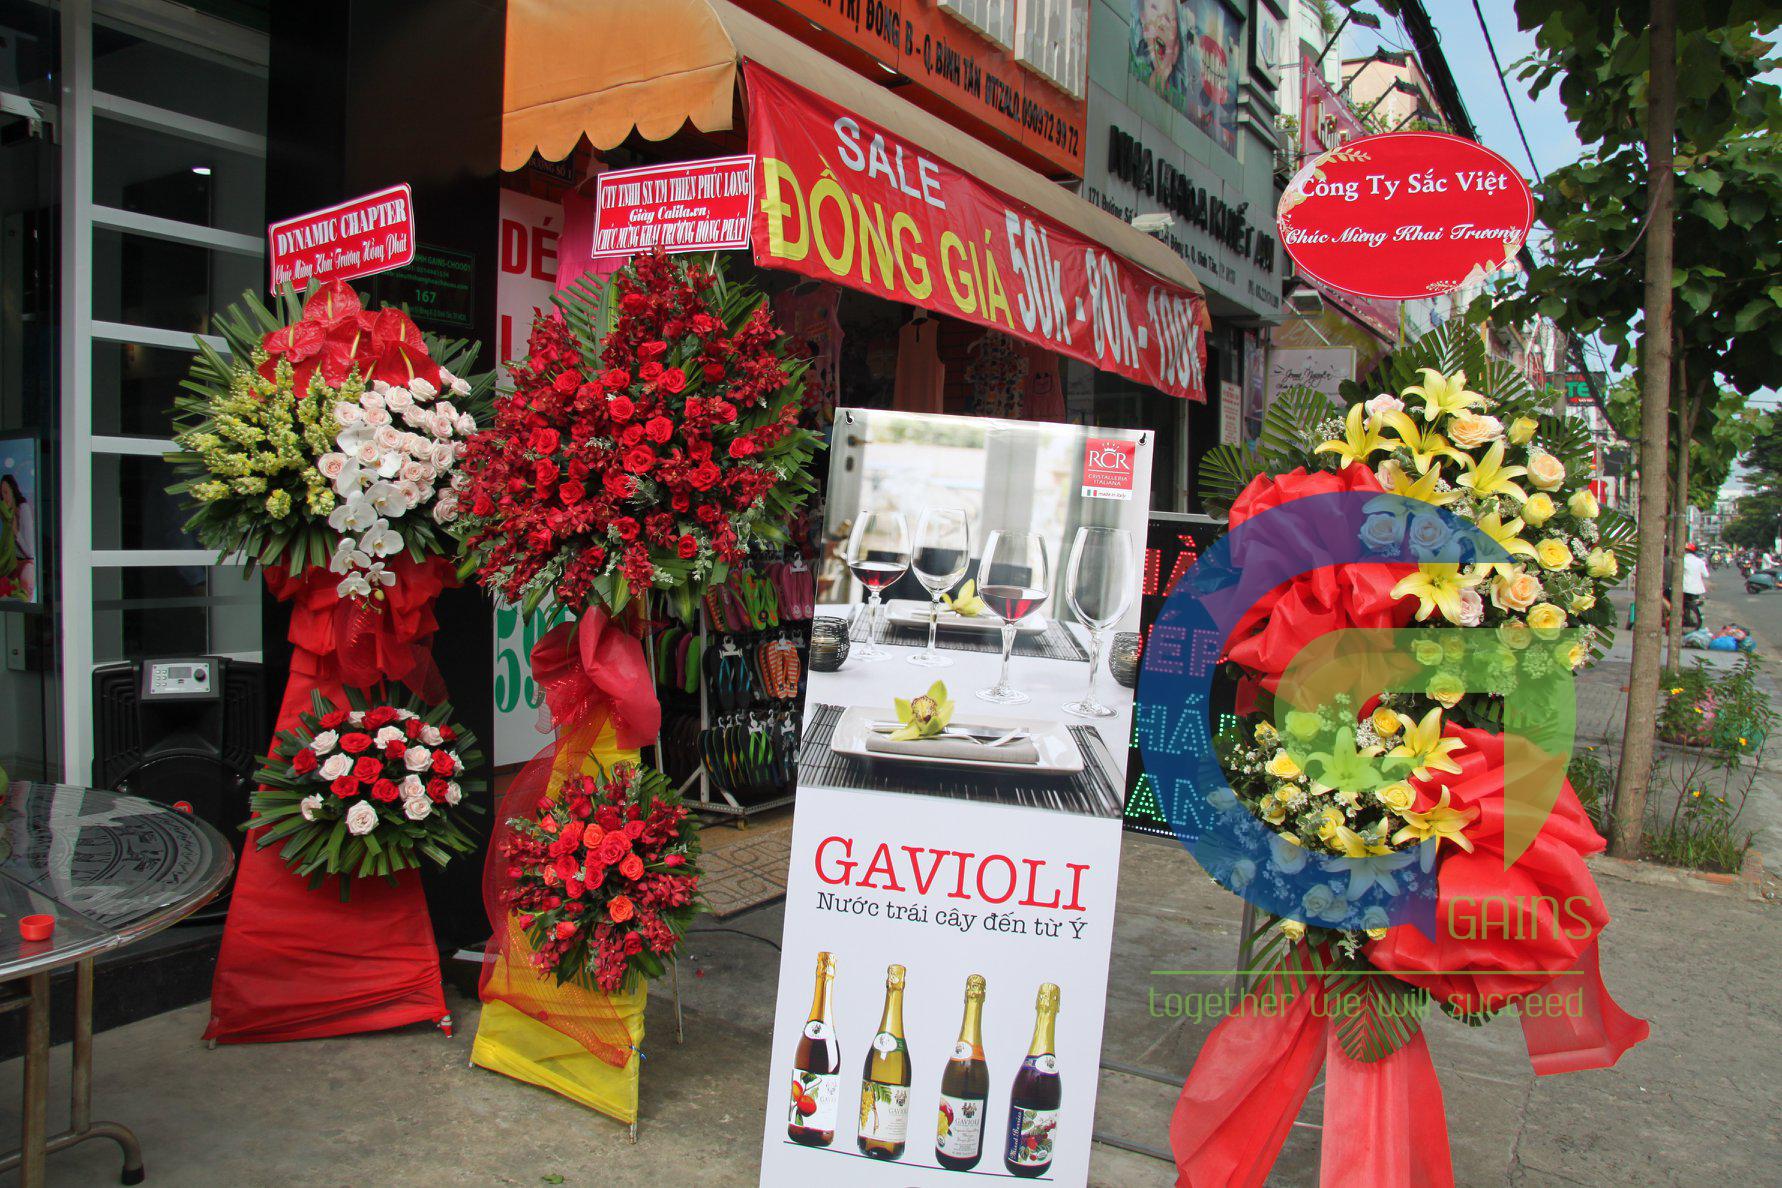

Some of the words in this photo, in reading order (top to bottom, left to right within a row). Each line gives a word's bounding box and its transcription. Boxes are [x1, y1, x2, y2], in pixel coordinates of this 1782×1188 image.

[1069, 125, 1079, 158] 72
[833, 117, 946, 210] SALE
[601, 185, 618, 209] CTY
[618, 182, 641, 207] TNHH
[655, 178, 668, 203] TM
[698, 167, 723, 200] PHÚC
[724, 169, 750, 197] LONG
[1088, 187, 1100, 206] 171
[1300, 176, 1359, 202] Công
[1365, 174, 1400, 201] Ty
[1407, 168, 1448, 194] Sắc
[1455, 170, 1509, 196] Việt
[277, 218, 338, 256] DYNAMIC
[340, 198, 407, 239] CHAPTER
[599, 222, 618, 250] CHÚC
[616, 221, 640, 249] MỪNG
[640, 224, 660, 247] KHAI
[720, 212, 746, 242] PHÁT
[760, 154, 933, 300] ĐỒNG
[939, 228, 1015, 330] GIÁ
[1285, 227, 1329, 245] Chúc
[1331, 226, 1388, 248] Mừng
[1392, 224, 1444, 242] Khai
[1450, 223, 1523, 245] Trương
[314, 252, 333, 275] Khai
[386, 232, 407, 261] Phát
[502, 217, 559, 283] DÉ
[415, 289, 437, 304] 167
[1088, 450, 1130, 470] RCR
[1137, 610, 1228, 677] ÉP
[815, 836, 1091, 911] GAVIOLI
[816, 891, 879, 917] Nước
[886, 898, 929, 923] trái
[935, 908, 977, 933] cây
[983, 911, 1027, 934] đến
[1034, 917, 1062, 938] từ
[1069, 916, 1088, 940] Ý
